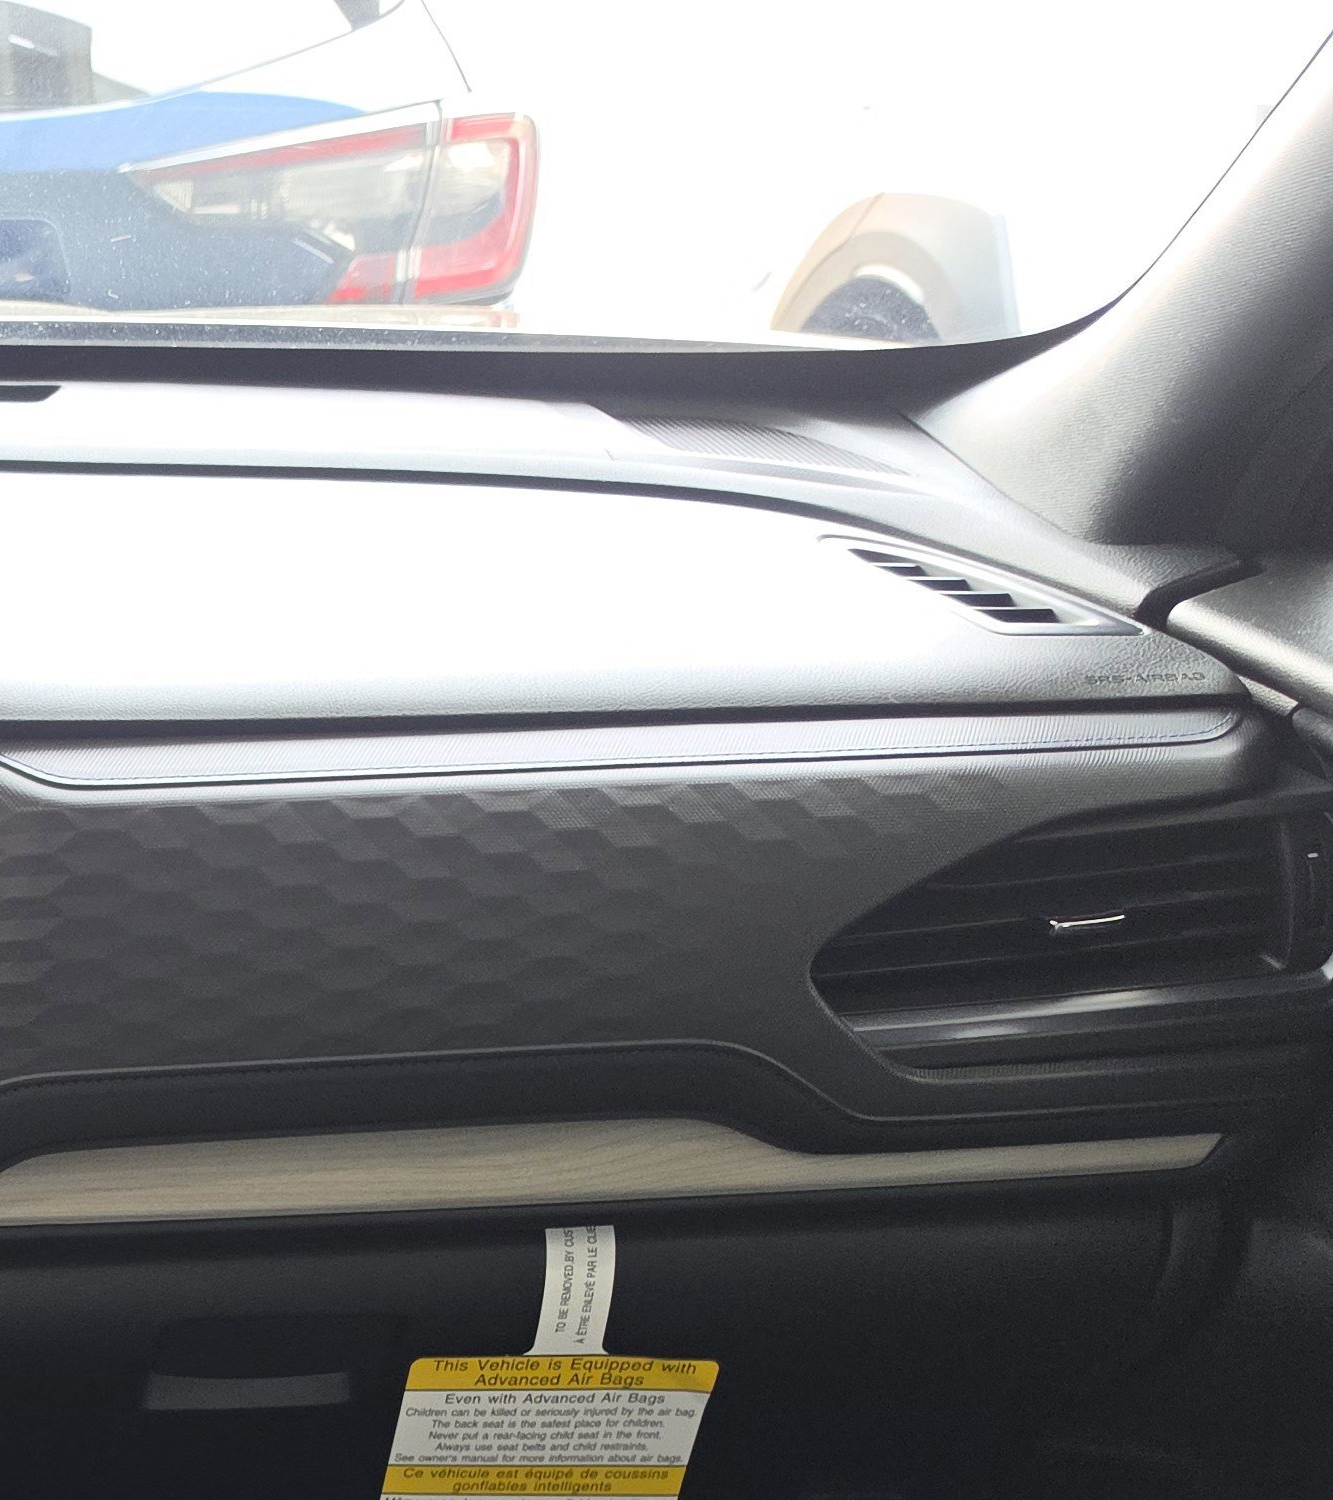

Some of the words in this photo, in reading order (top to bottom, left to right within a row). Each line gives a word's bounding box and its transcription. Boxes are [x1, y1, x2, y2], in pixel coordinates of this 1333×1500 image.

[564, 1251, 575, 1264] BY
[587, 1246, 598, 1258] LE
[586, 1260, 597, 1279] PAR
[559, 1264, 574, 1307] REMOVED
[557, 1308, 569, 1320] BE
[555, 1321, 566, 1334] TO
[433, 1359, 469, 1372] This
[478, 1358, 541, 1372] Vehicle
[547, 1358, 563, 1371] is
[569, 1357, 654, 1373] Equipped
[661, 1361, 697, 1375] with
[474, 1373, 561, 1386] Advanced
[567, 1372, 593, 1386] Air
[599, 1372, 645, 1388] Bags
[444, 1393, 481, 1405] Even
[487, 1393, 517, 1404] with
[522, 1393, 596, 1404] Advanced
[600, 1392, 622, 1403] Air
[627, 1392, 666, 1406] Bags
[405, 1407, 447, 1417] Children
[451, 1409, 470, 1417] can
[473, 1408, 487, 1417] be
[490, 1407, 517, 1417] killed
[520, 1409, 532, 1417] or
[535, 1407, 580, 1418] seriously
[583, 1407, 619, 1418] injured
[621, 1407, 634, 1418] by
[637, 1407, 654, 1416] the
[657, 1408, 672, 1416] air
[432, 1419, 451, 1429] The
[454, 1419, 478, 1429] back
[482, 1420, 505, 1429] seat
[507, 1420, 517, 1429] is
[520, 1419, 537, 1429] the
[540, 1419, 571, 1429] safest
[574, 1419, 602, 1429] place
[605, 1418, 620, 1428] for
[428, 1430, 459, 1440] Never
[461, 1431, 479, 1442] put
[481, 1432, 489, 1440] a
[493, 1430, 547, 1442] rear-facing
[550, 1430, 575, 1440] child
[577, 1431, 600, 1440] seat
[602, 1431, 613, 1439] in
[615, 1430, 633, 1440] the
[435, 1442, 471, 1453] Always
[474, 1444, 493, 1452] use
[496, 1443, 519, 1452] seat
[522, 1443, 546, 1452] belts
[550, 1442, 571, 1452] and
[573, 1442, 598, 1452] child
[403, 1468, 424, 1479] Ce
[430, 1468, 490, 1479] véhicule
[495, 1468, 519, 1479] est
[524, 1468, 574, 1481] équipé
[580, 1469, 599, 1480] de
[604, 1469, 669, 1480] coussins
[452, 1480, 528, 1494] gonflables
[533, 1480, 612, 1494] intelligents
